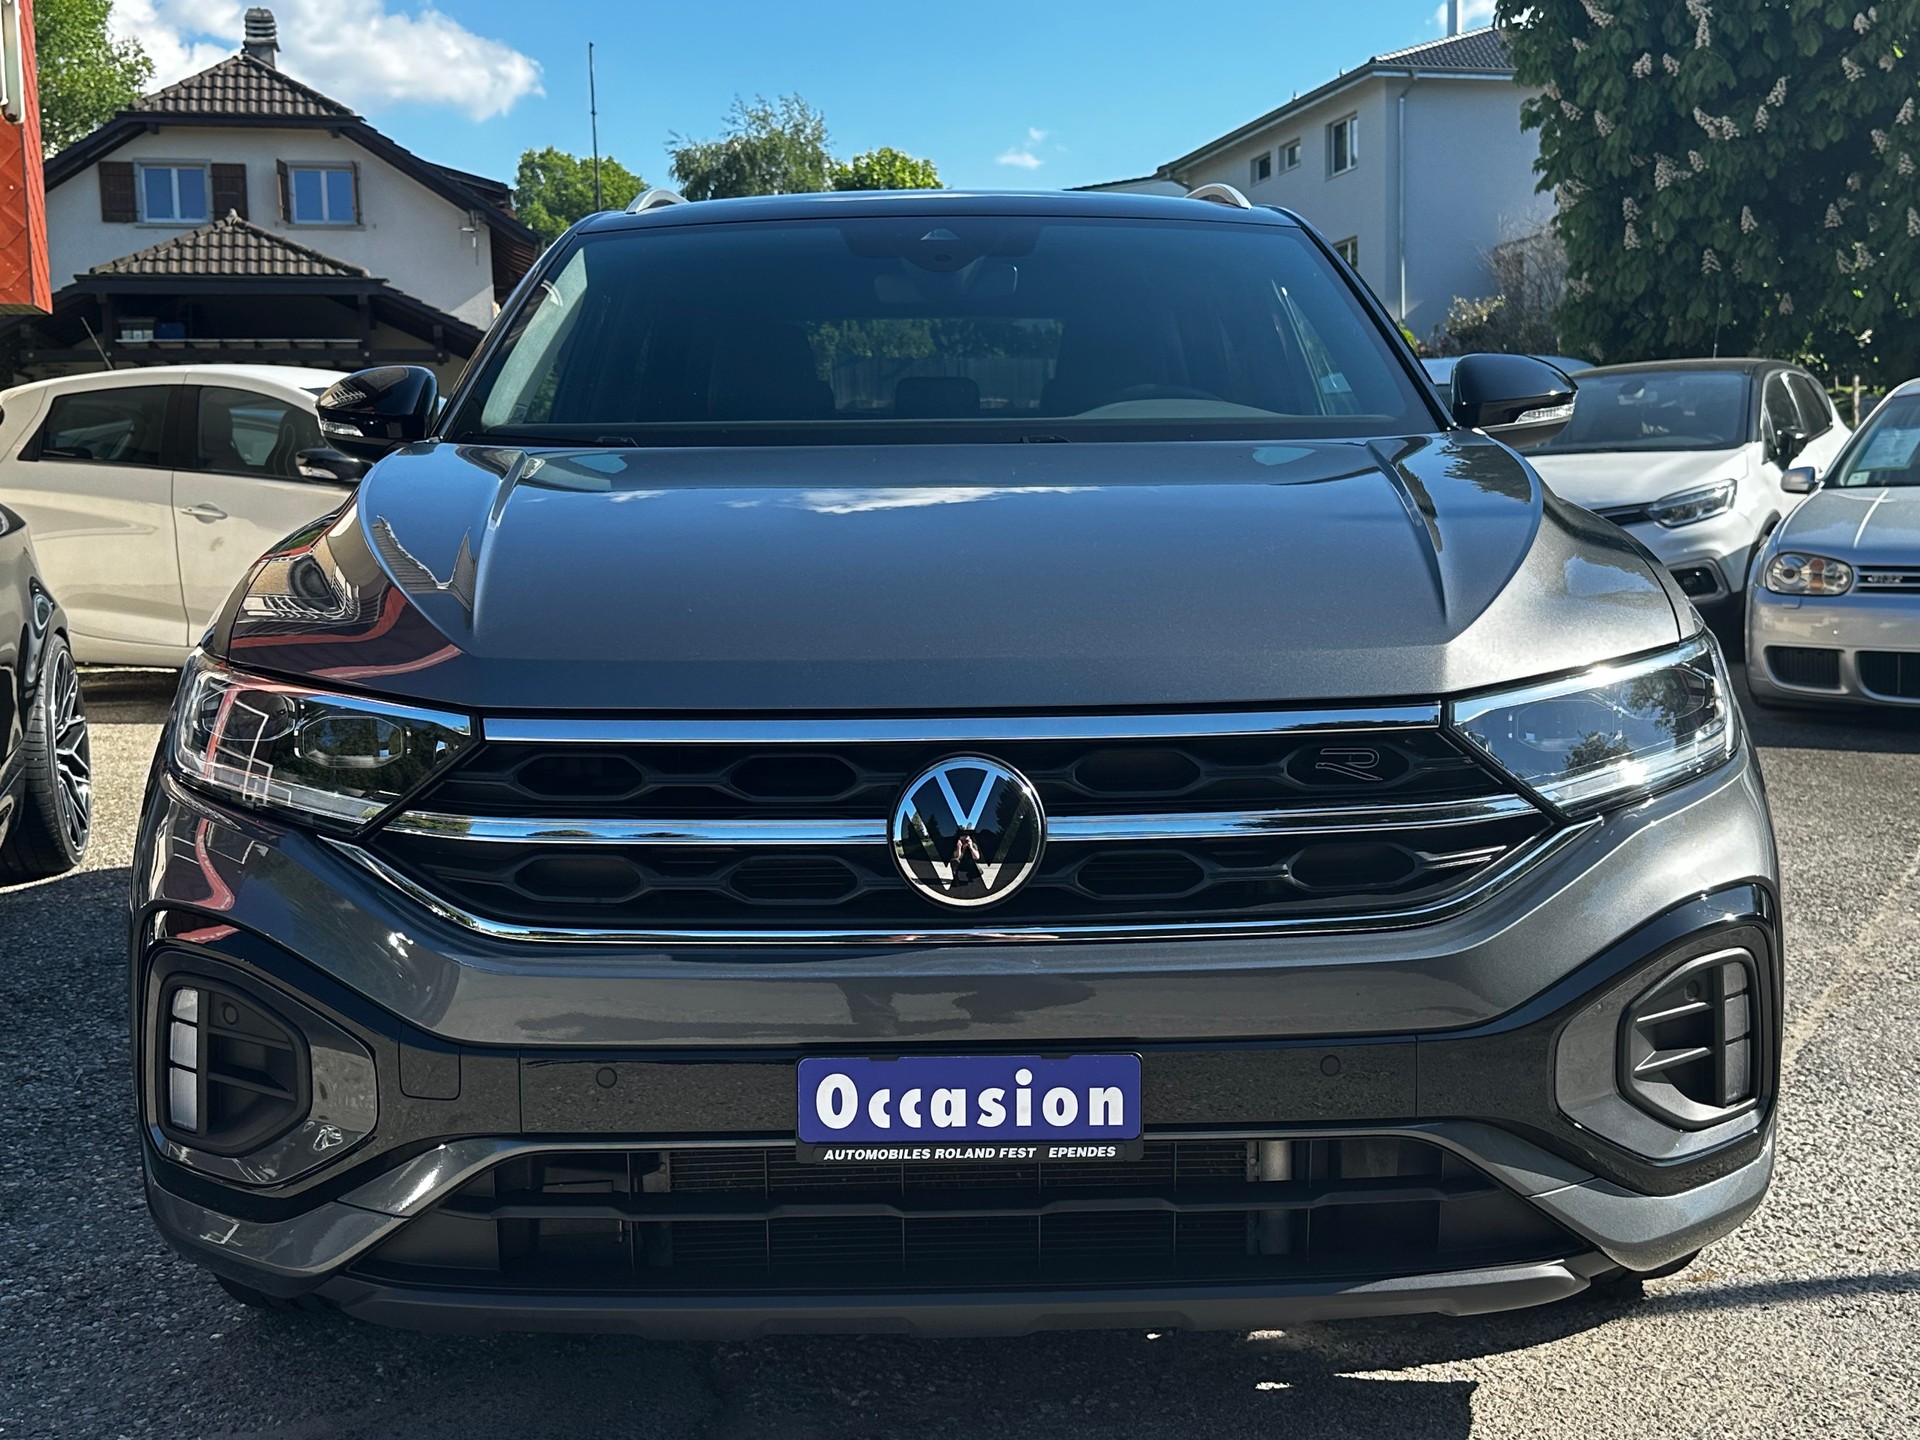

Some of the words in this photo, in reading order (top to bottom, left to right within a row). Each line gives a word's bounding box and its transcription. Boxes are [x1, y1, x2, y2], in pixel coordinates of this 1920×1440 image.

[1315, 748, 1382, 780] R
[816, 1069, 1124, 1129] Occasion
[824, 1149, 931, 1161] AUTOMOBILES
[934, 1148, 995, 1160] ROLAND
[999, 1147, 1037, 1159] FEST
[1048, 1146, 1117, 1159] EPENDES
